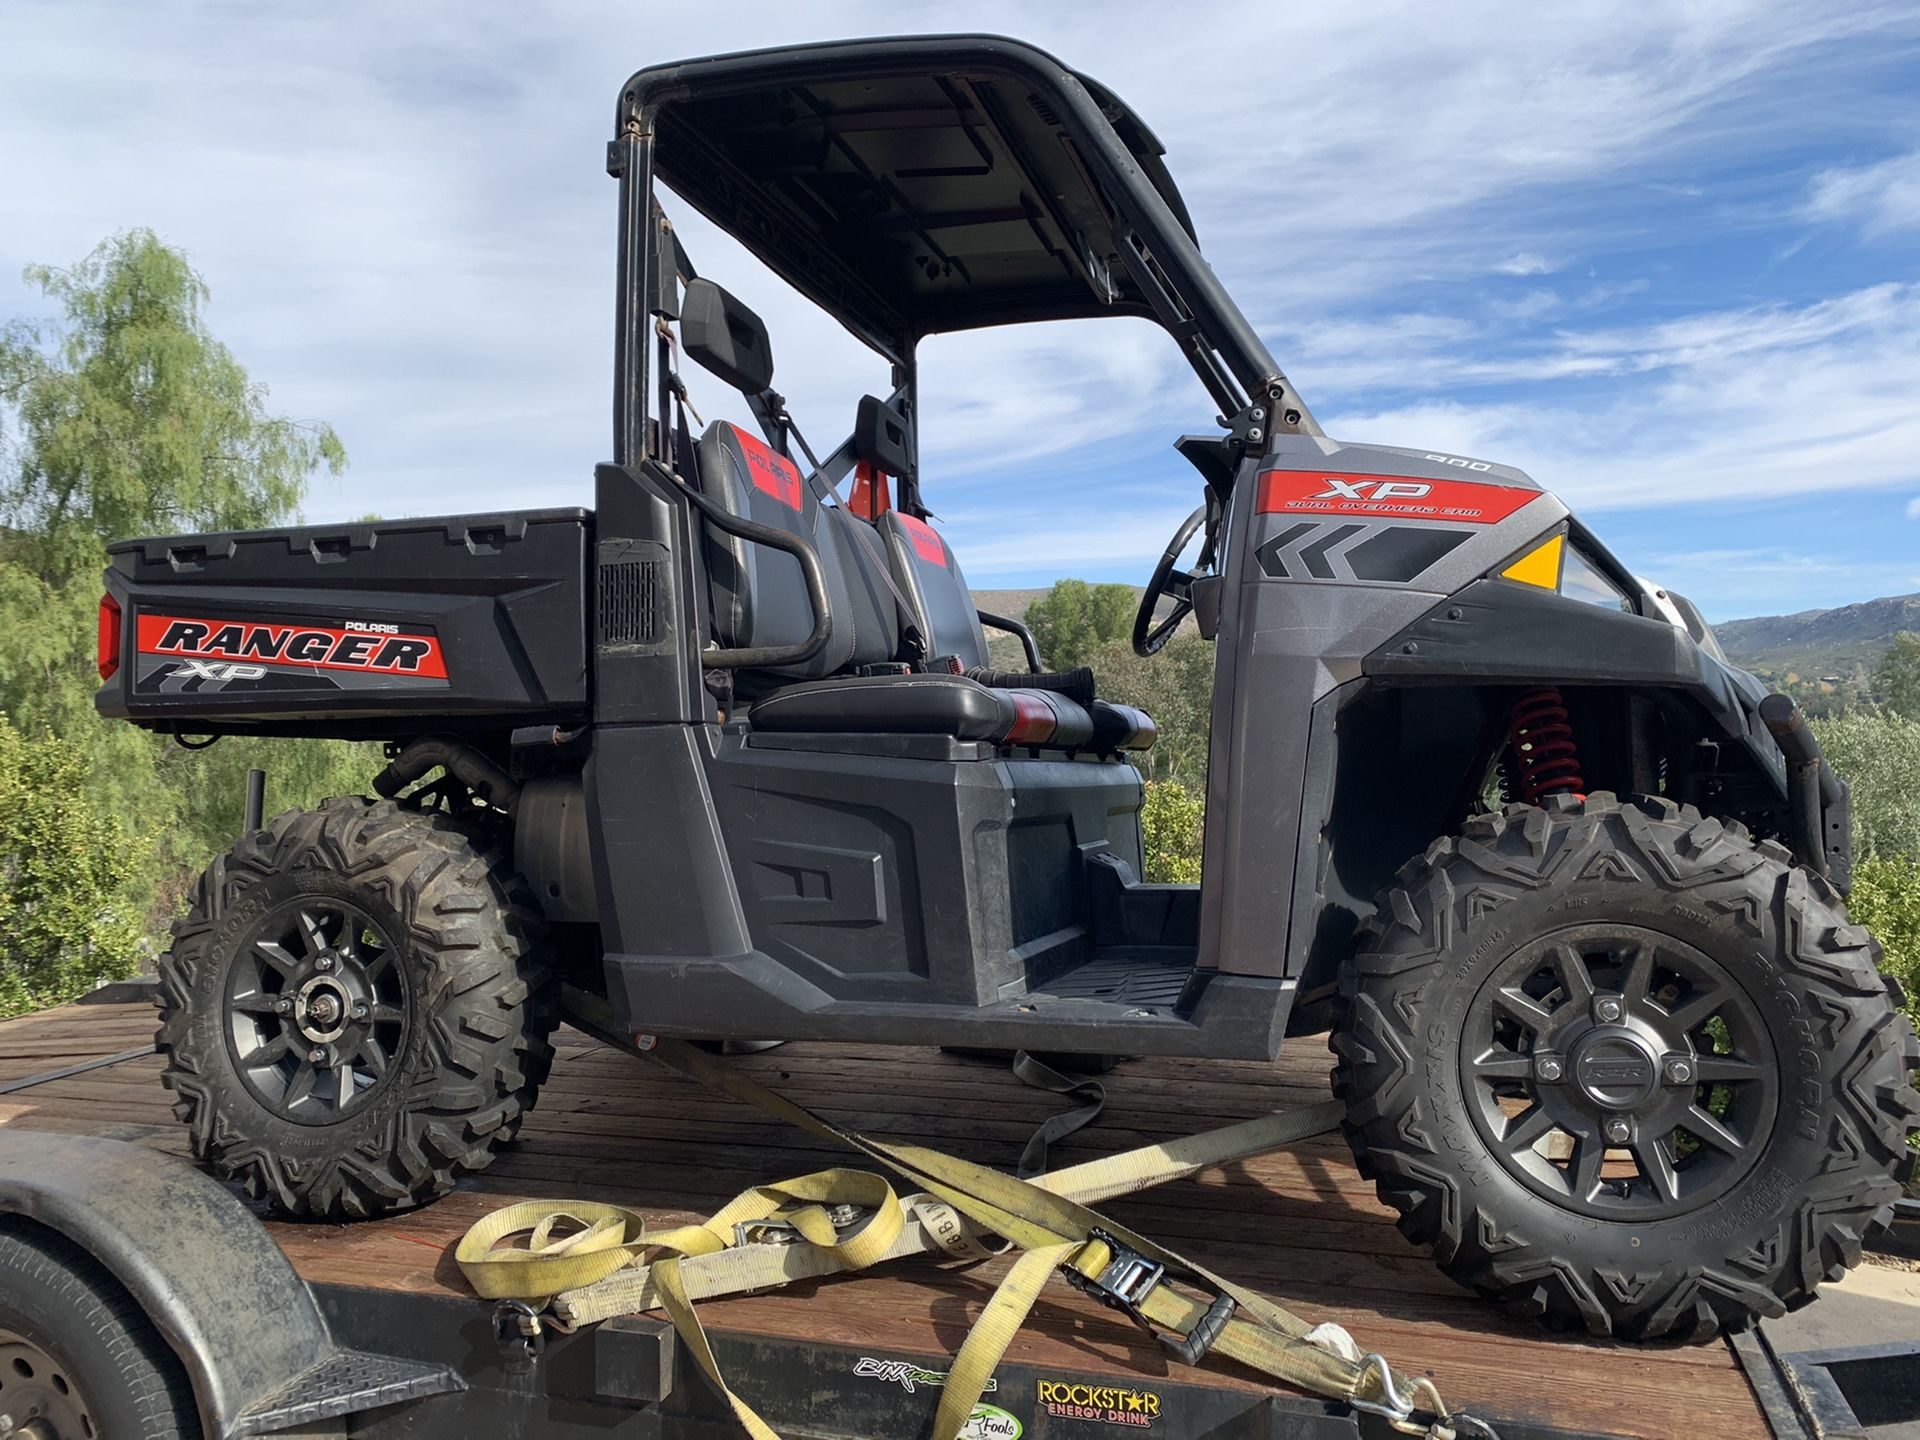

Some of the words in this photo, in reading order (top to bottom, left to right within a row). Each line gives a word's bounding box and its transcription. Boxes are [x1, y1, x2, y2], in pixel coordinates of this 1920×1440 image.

[1307, 479, 1433, 501] XP
[344, 620, 400, 635] POLARIS
[156, 621, 429, 672] RANGER
[165, 658, 268, 682] XP
[1048, 1402, 1103, 1419] ENERGY
[1108, 1409, 1150, 1425] DRINK
[983, 1417, 1015, 1436] Fools
